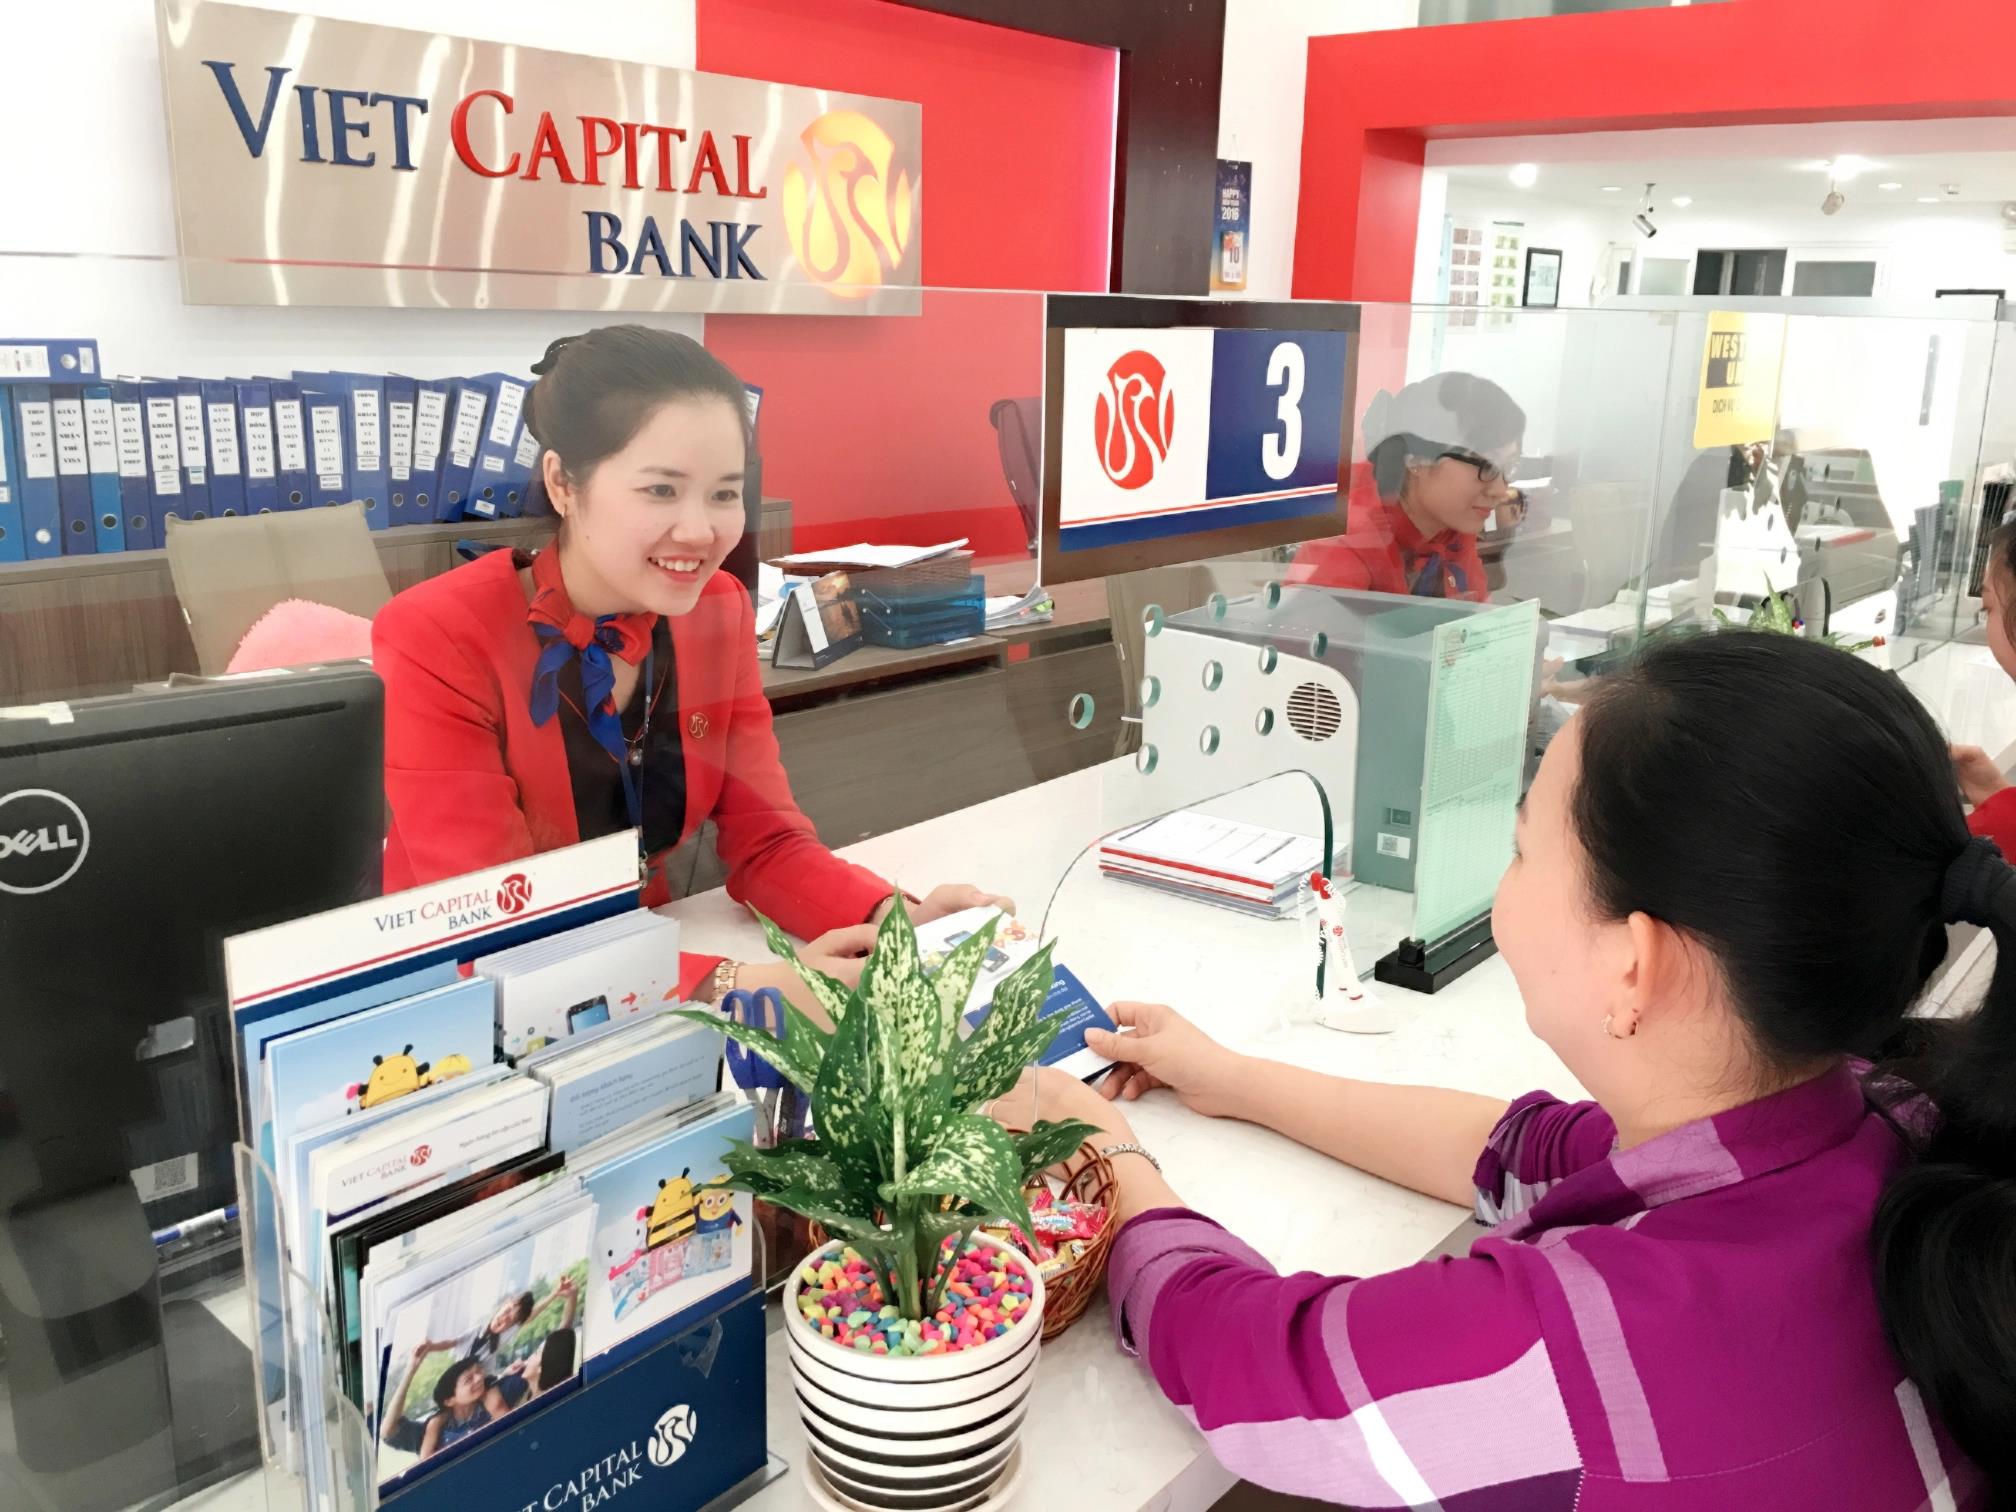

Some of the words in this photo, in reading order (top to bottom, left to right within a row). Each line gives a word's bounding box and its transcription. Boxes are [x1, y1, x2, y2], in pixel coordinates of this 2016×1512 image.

[202, 60, 429, 171] VIET
[451, 89, 767, 198] CAPITAL
[1221, 206, 1239, 220] 2016
[1222, 188, 1240, 200] HAPPY
[583, 210, 768, 280] BANK
[1262, 341, 1305, 480] 3
[374, 909, 417, 932] VIET
[421, 889, 492, 920] CAPITAL
[448, 906, 492, 930] BANK
[341, 1172, 365, 1188] VIET
[366, 1155, 407, 1178] CAPITAL
[380, 1166, 407, 1180] BANK
[543, 1441, 643, 1511] CAPITAL
[581, 1462, 643, 1512] BANK
